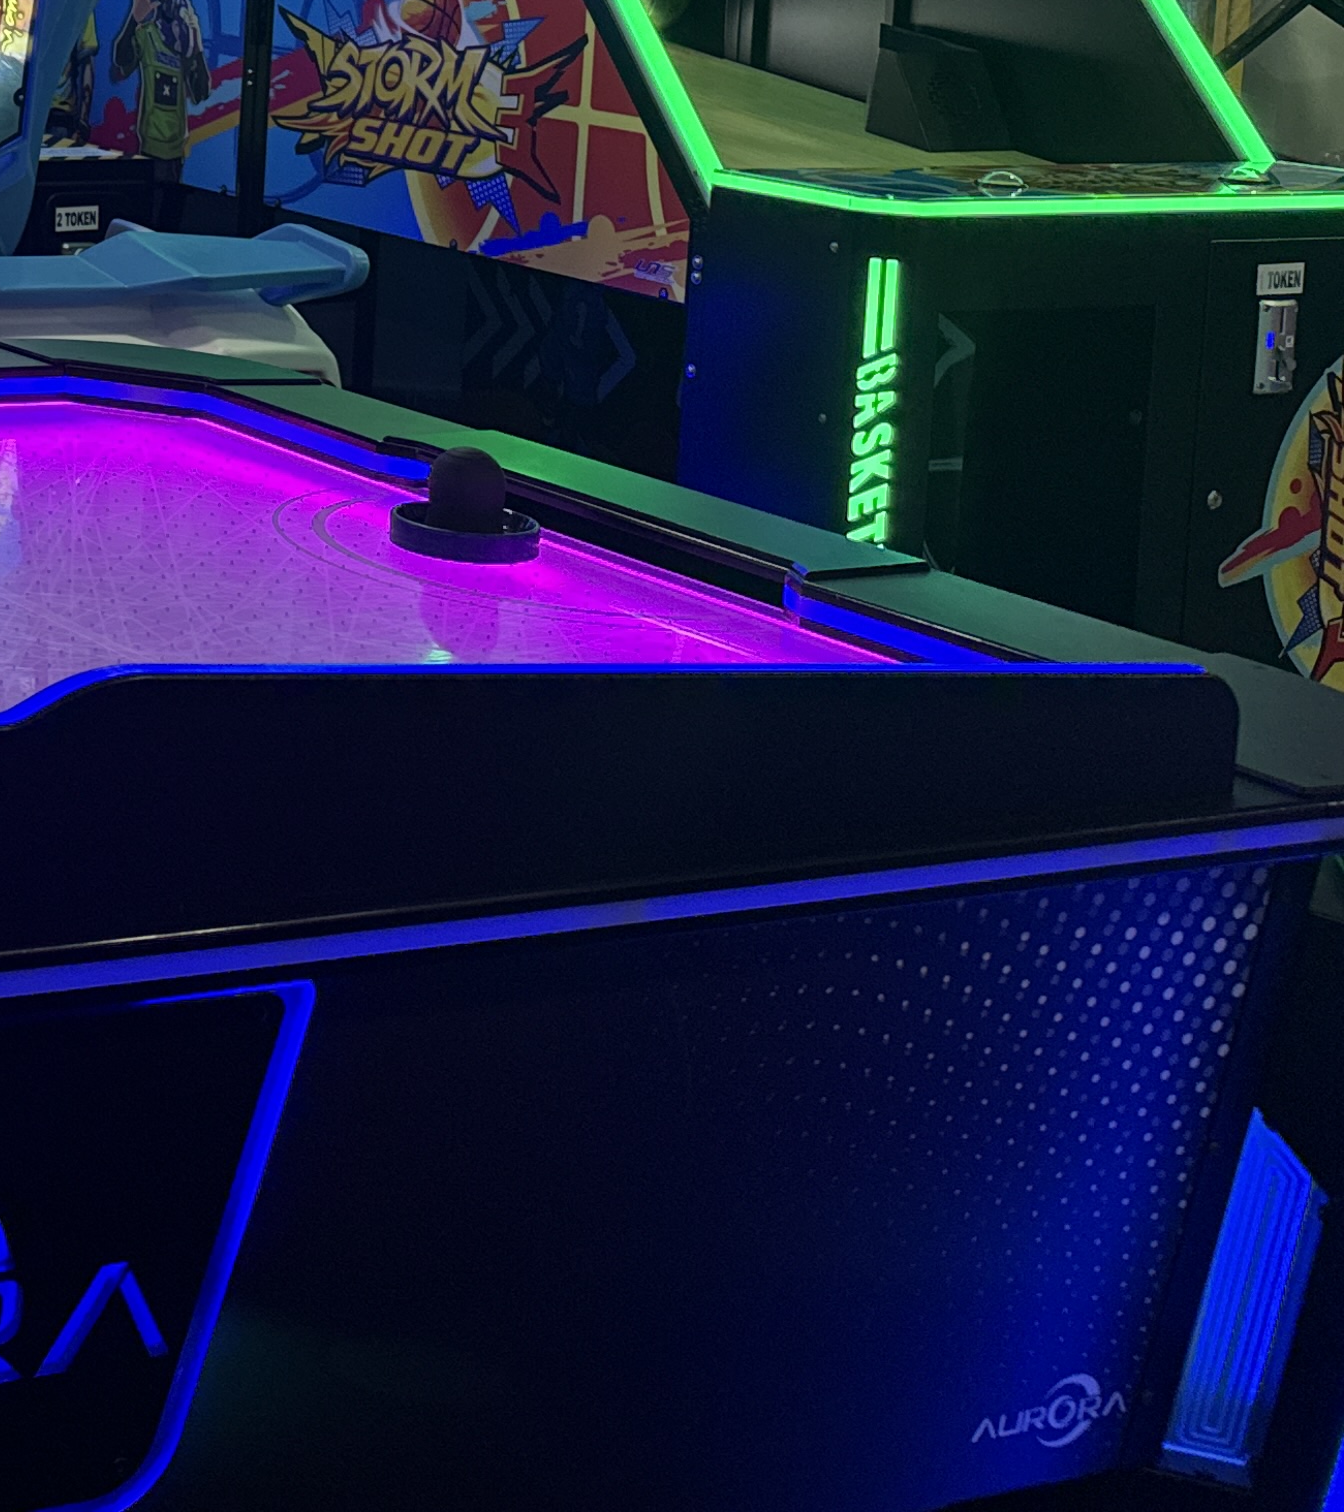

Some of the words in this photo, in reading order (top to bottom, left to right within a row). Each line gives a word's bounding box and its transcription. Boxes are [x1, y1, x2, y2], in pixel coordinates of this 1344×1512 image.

[309, 34, 508, 142] STORM
[348, 118, 479, 172] SHOT
[57, 212, 63, 228] 2
[64, 211, 97, 227] TOKEN
[1267, 270, 1302, 289] TOKEN
[846, 351, 900, 546] BASKET
[972, 1382, 1127, 1446] AURORA
